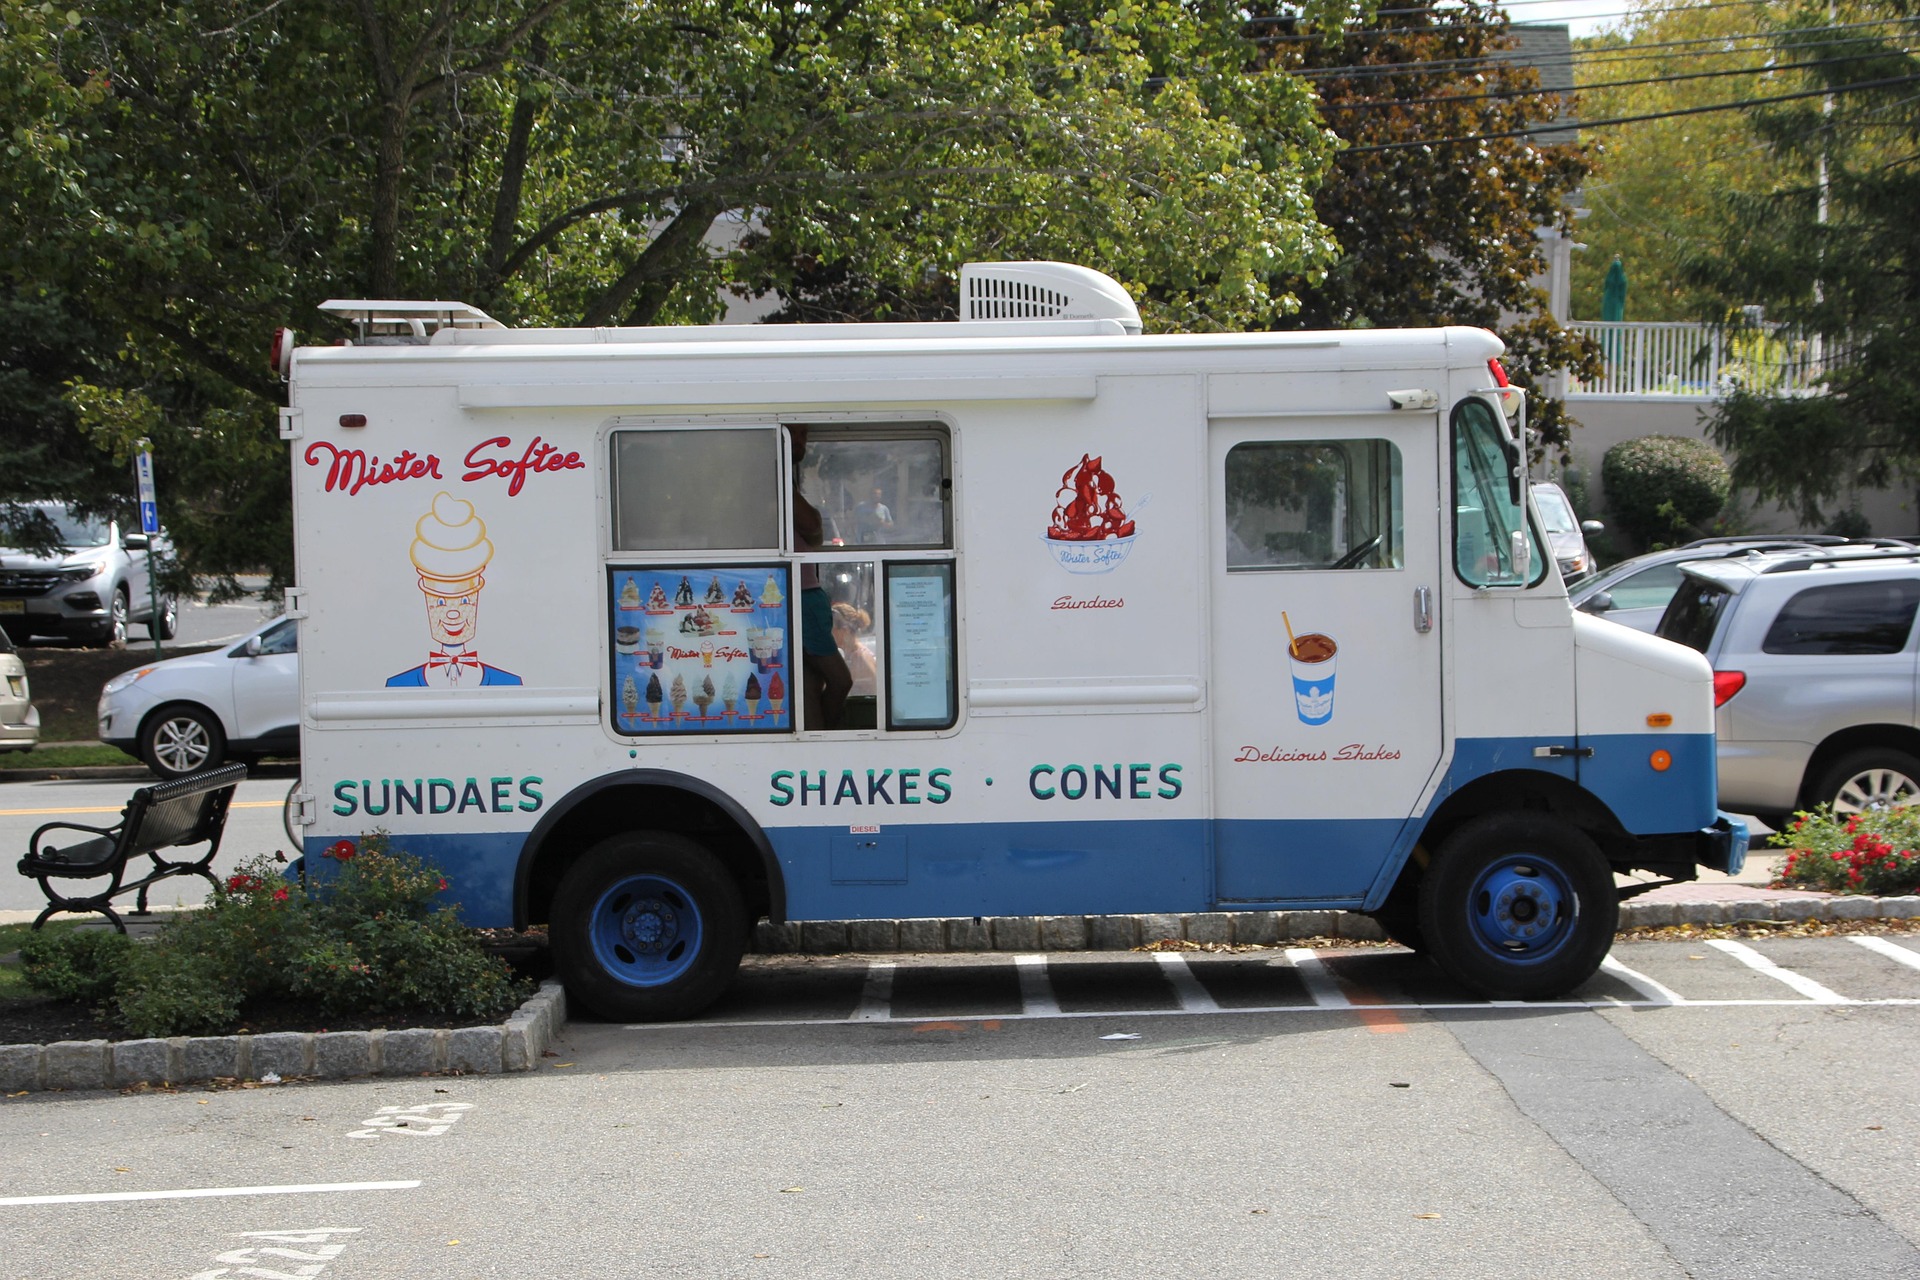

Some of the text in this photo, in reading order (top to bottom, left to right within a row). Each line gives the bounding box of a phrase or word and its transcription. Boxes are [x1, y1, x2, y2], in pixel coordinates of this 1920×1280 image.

[304, 436, 585, 497] Mister Softee
[1060, 548, 1123, 565] Mister Softee
[1051, 595, 1124, 609] Sundaes
[667, 646, 748, 662] Mister Softee
[1234, 744, 1401, 762] Delicious Shakes
[769, 763, 1182, 806] SHAKES CONES
[333, 776, 543, 816] SUNDAES
